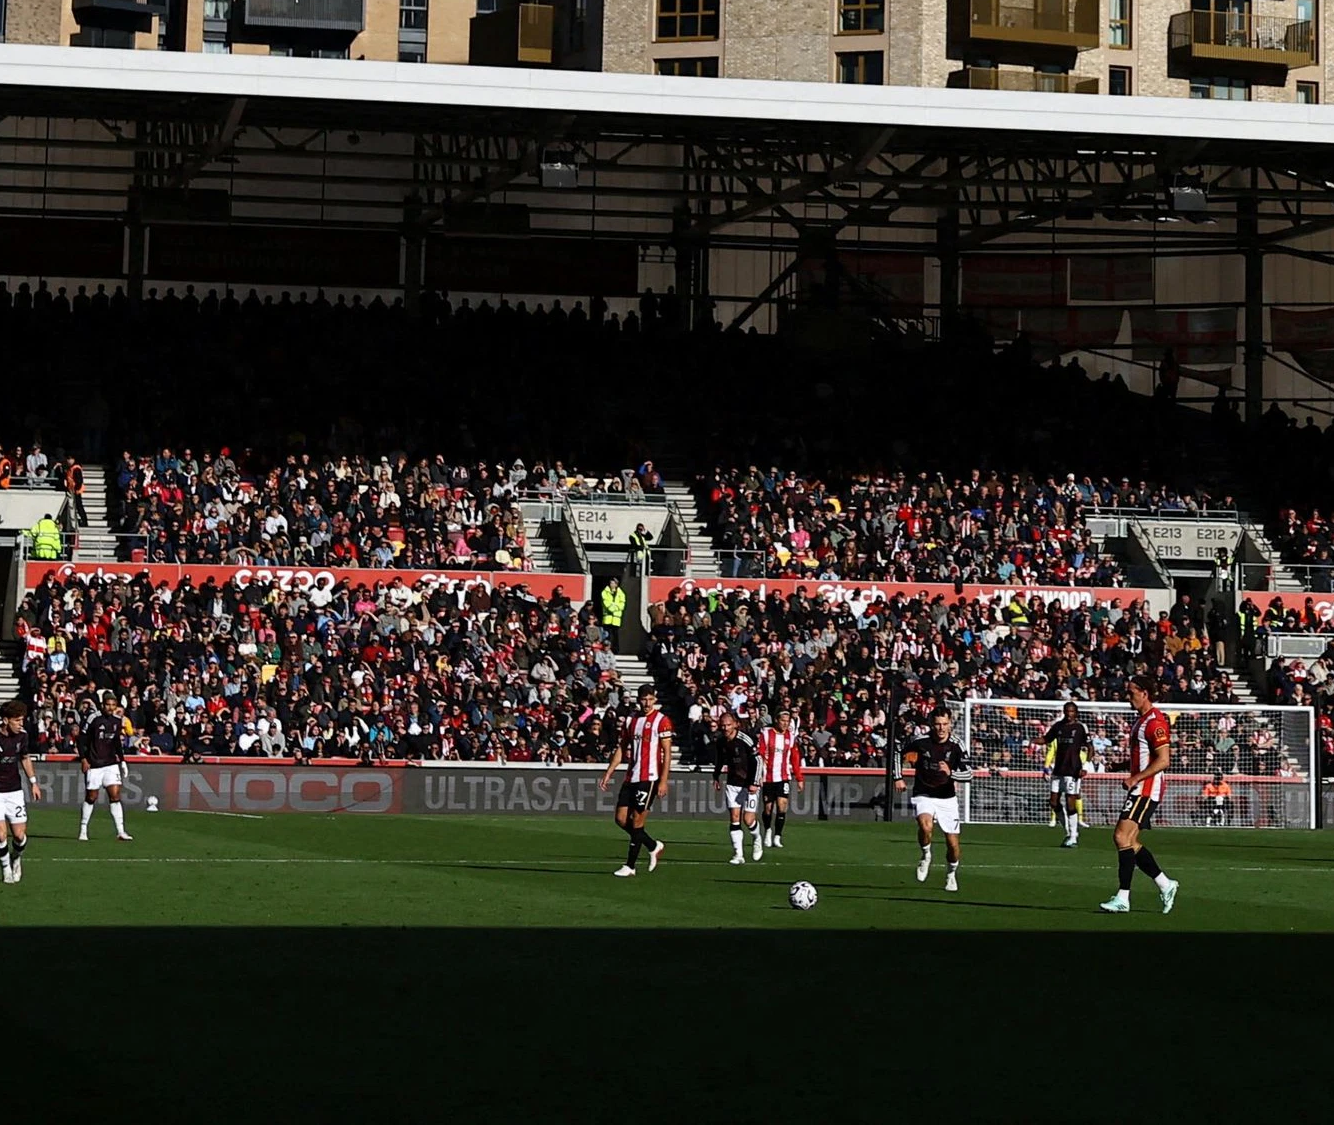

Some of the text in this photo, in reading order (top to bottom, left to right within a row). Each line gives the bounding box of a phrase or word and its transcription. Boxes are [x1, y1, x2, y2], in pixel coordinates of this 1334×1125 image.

[578, 512, 607, 522] E214
[578, 530, 603, 541] E114
[1153, 528, 1225, 540] E213 E212
[1157, 546, 1182, 556] E113
[178, 770, 393, 813] NOCO
[425, 775, 615, 813] ULTRASAFE
[746, 798, 756, 810] 10
[953, 818, 960, 831] 7
